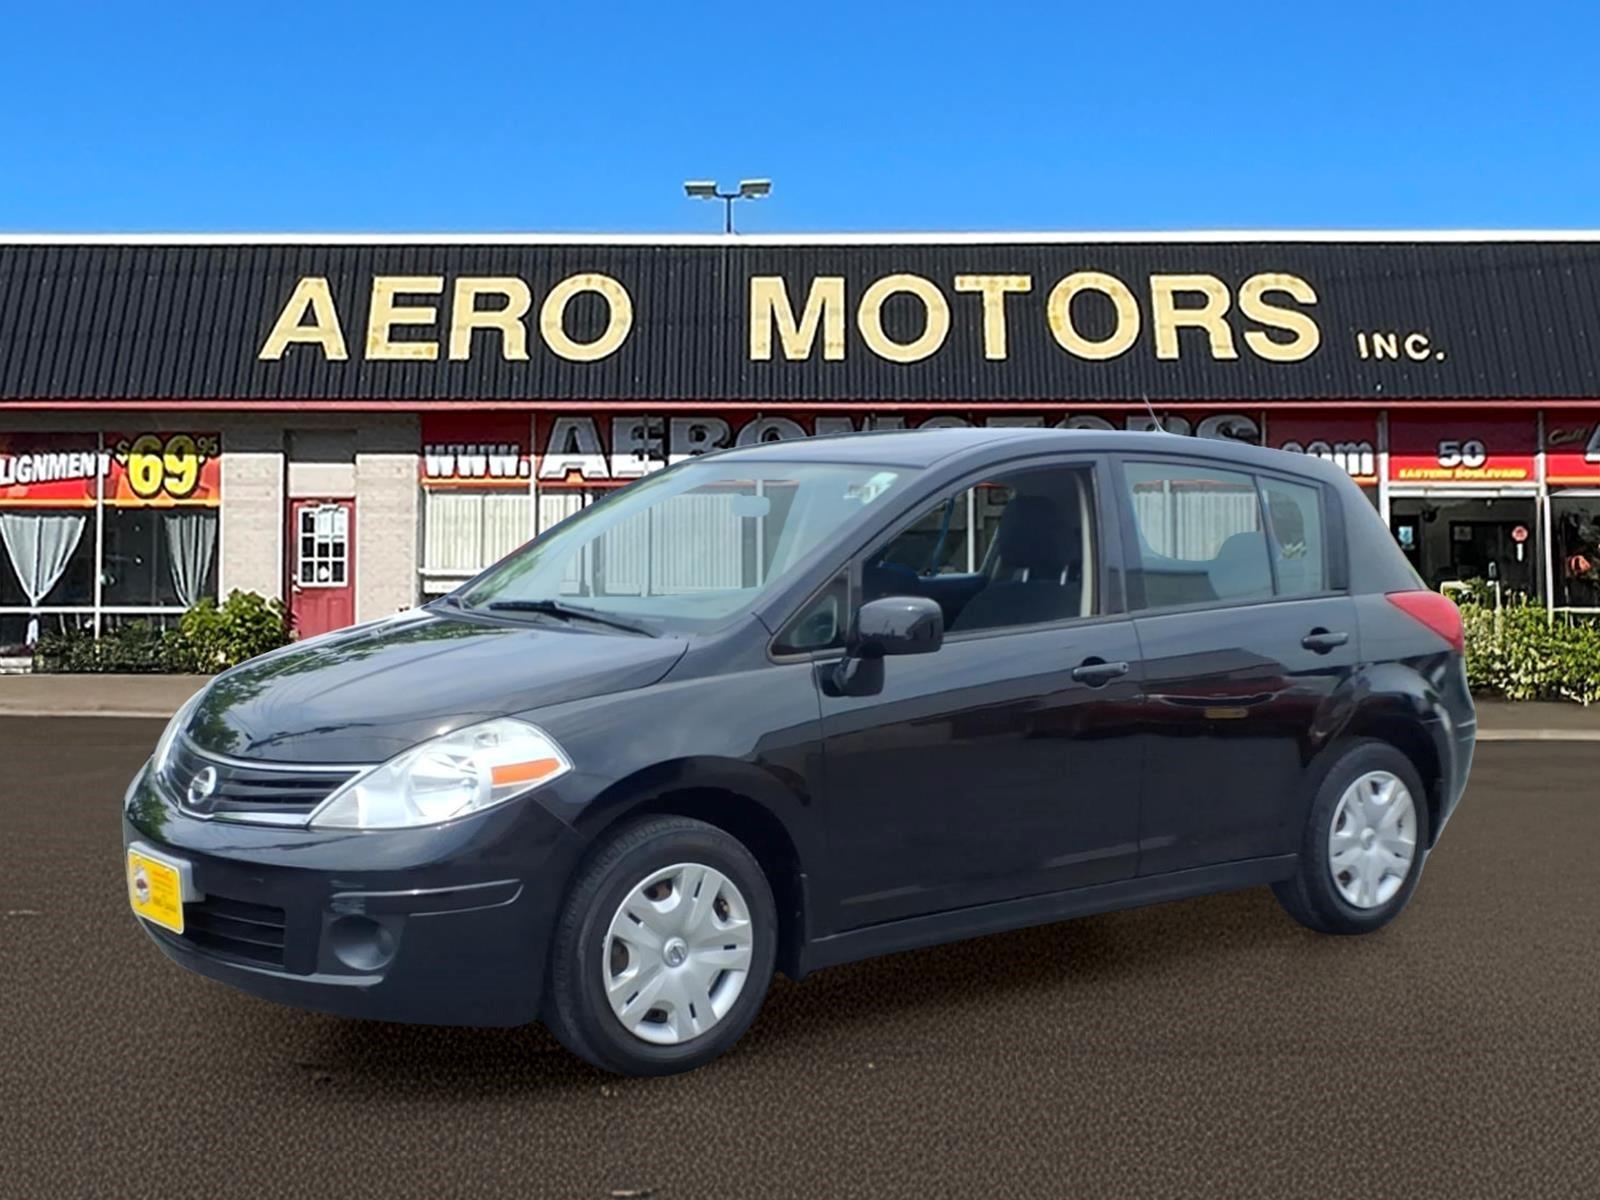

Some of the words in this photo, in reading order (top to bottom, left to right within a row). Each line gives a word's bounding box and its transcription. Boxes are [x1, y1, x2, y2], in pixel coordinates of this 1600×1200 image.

[258, 273, 633, 362] AERO
[750, 271, 1321, 362] MOTORS
[1357, 332, 1446, 361] INC.
[424, 444, 530, 477] www.
[1437, 440, 1486, 468] 50
[1399, 468, 1452, 479] EASTERN
[1455, 468, 1527, 479] BOULEVARD
